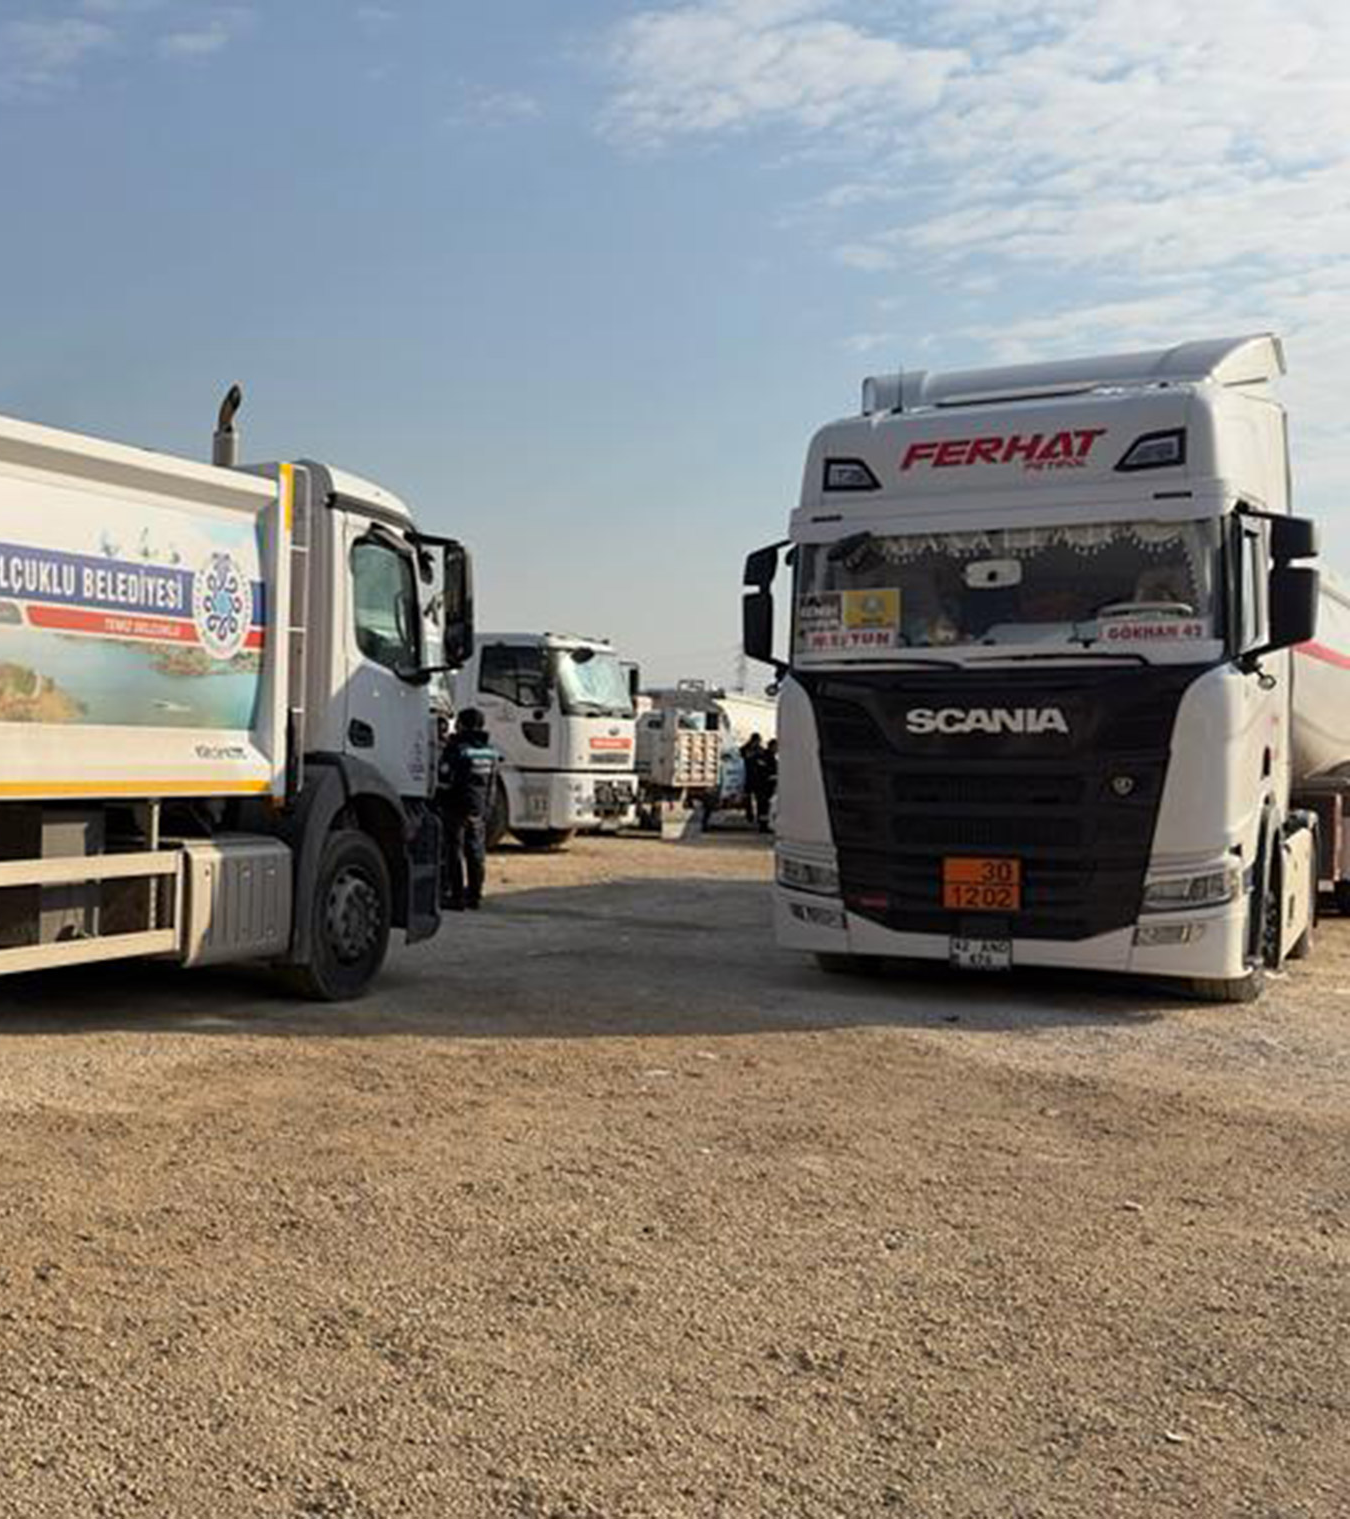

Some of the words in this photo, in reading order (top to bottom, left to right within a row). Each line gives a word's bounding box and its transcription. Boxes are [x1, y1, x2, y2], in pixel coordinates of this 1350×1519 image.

[901, 429, 1107, 470] FERHAT
[83, 568, 183, 610] BELEDİYESİ
[1108, 622, 1179, 640] GÖKHAN
[906, 707, 1069, 734] SCANIA
[981, 862, 1012, 881] 30
[952, 886, 1012, 908] 1202
